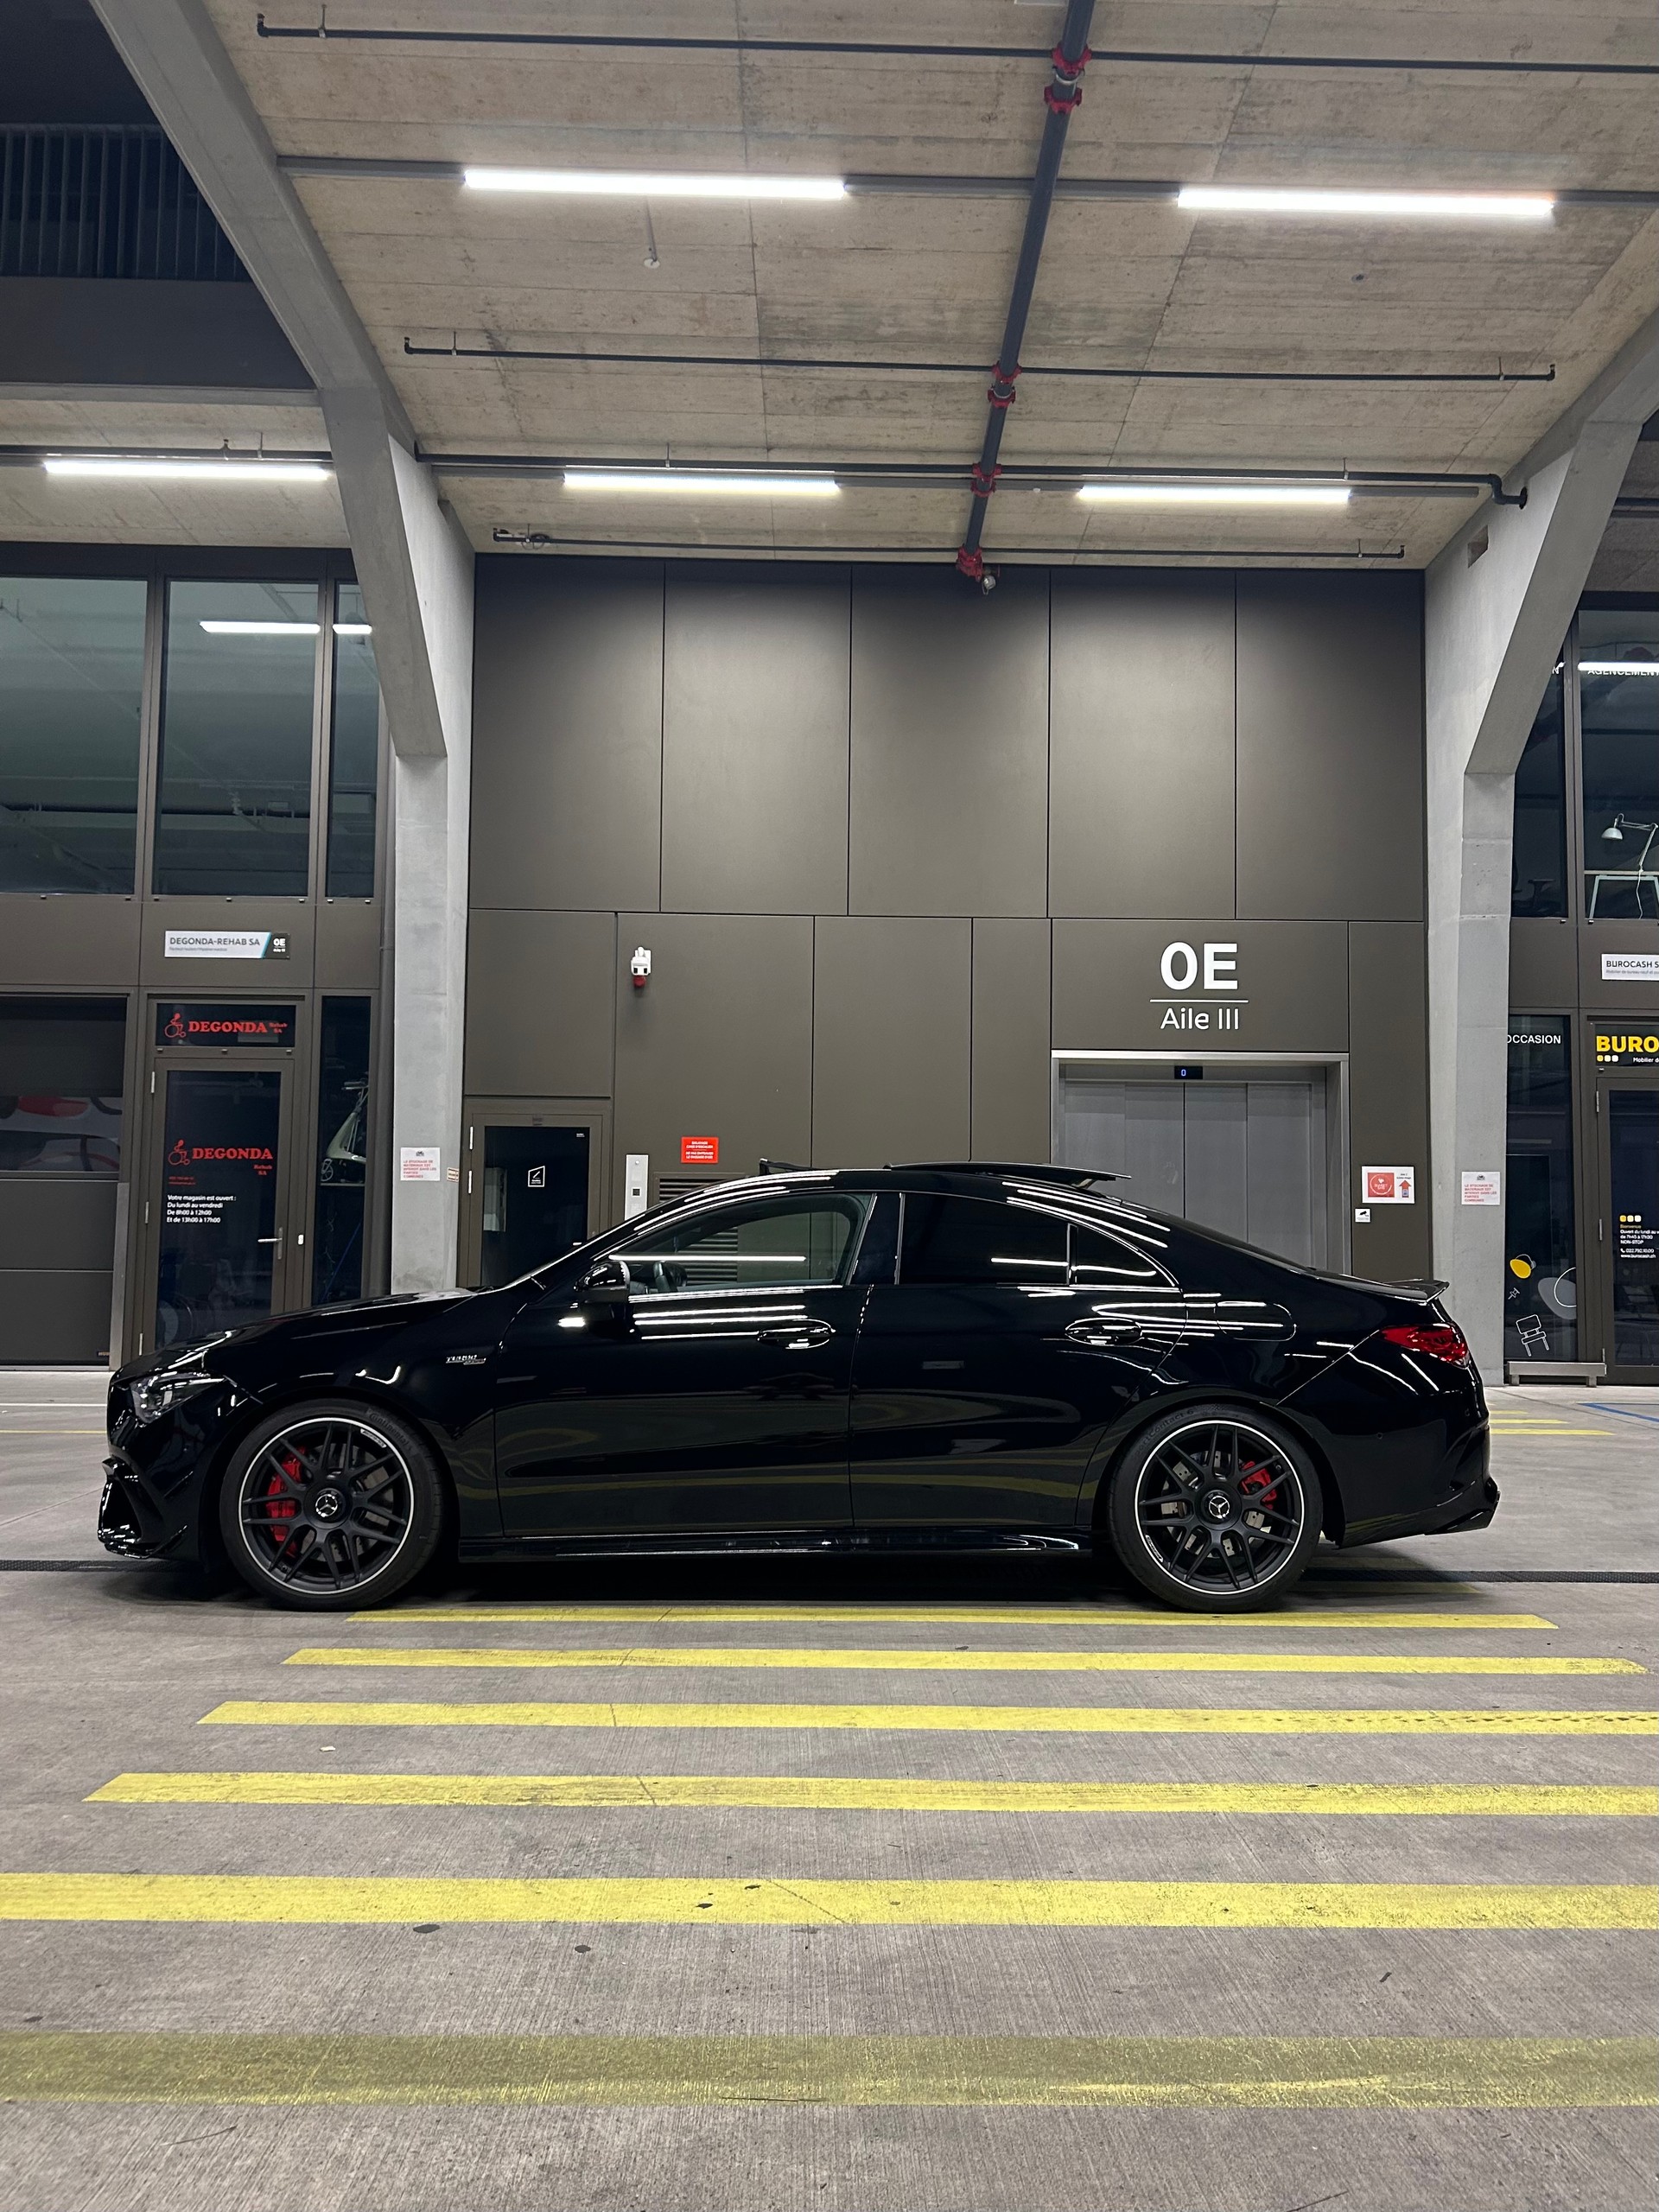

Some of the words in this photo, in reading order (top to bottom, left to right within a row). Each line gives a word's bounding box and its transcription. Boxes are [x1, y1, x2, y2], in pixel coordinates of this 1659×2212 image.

[169, 937, 247, 945] DEGONDA-REHAB
[1160, 1007, 1210, 1030] Aile
[1218, 1007, 1239, 1030] III
[188, 1021, 268, 1033] DEGONDA
[192, 1147, 273, 1160] DEGONDA
